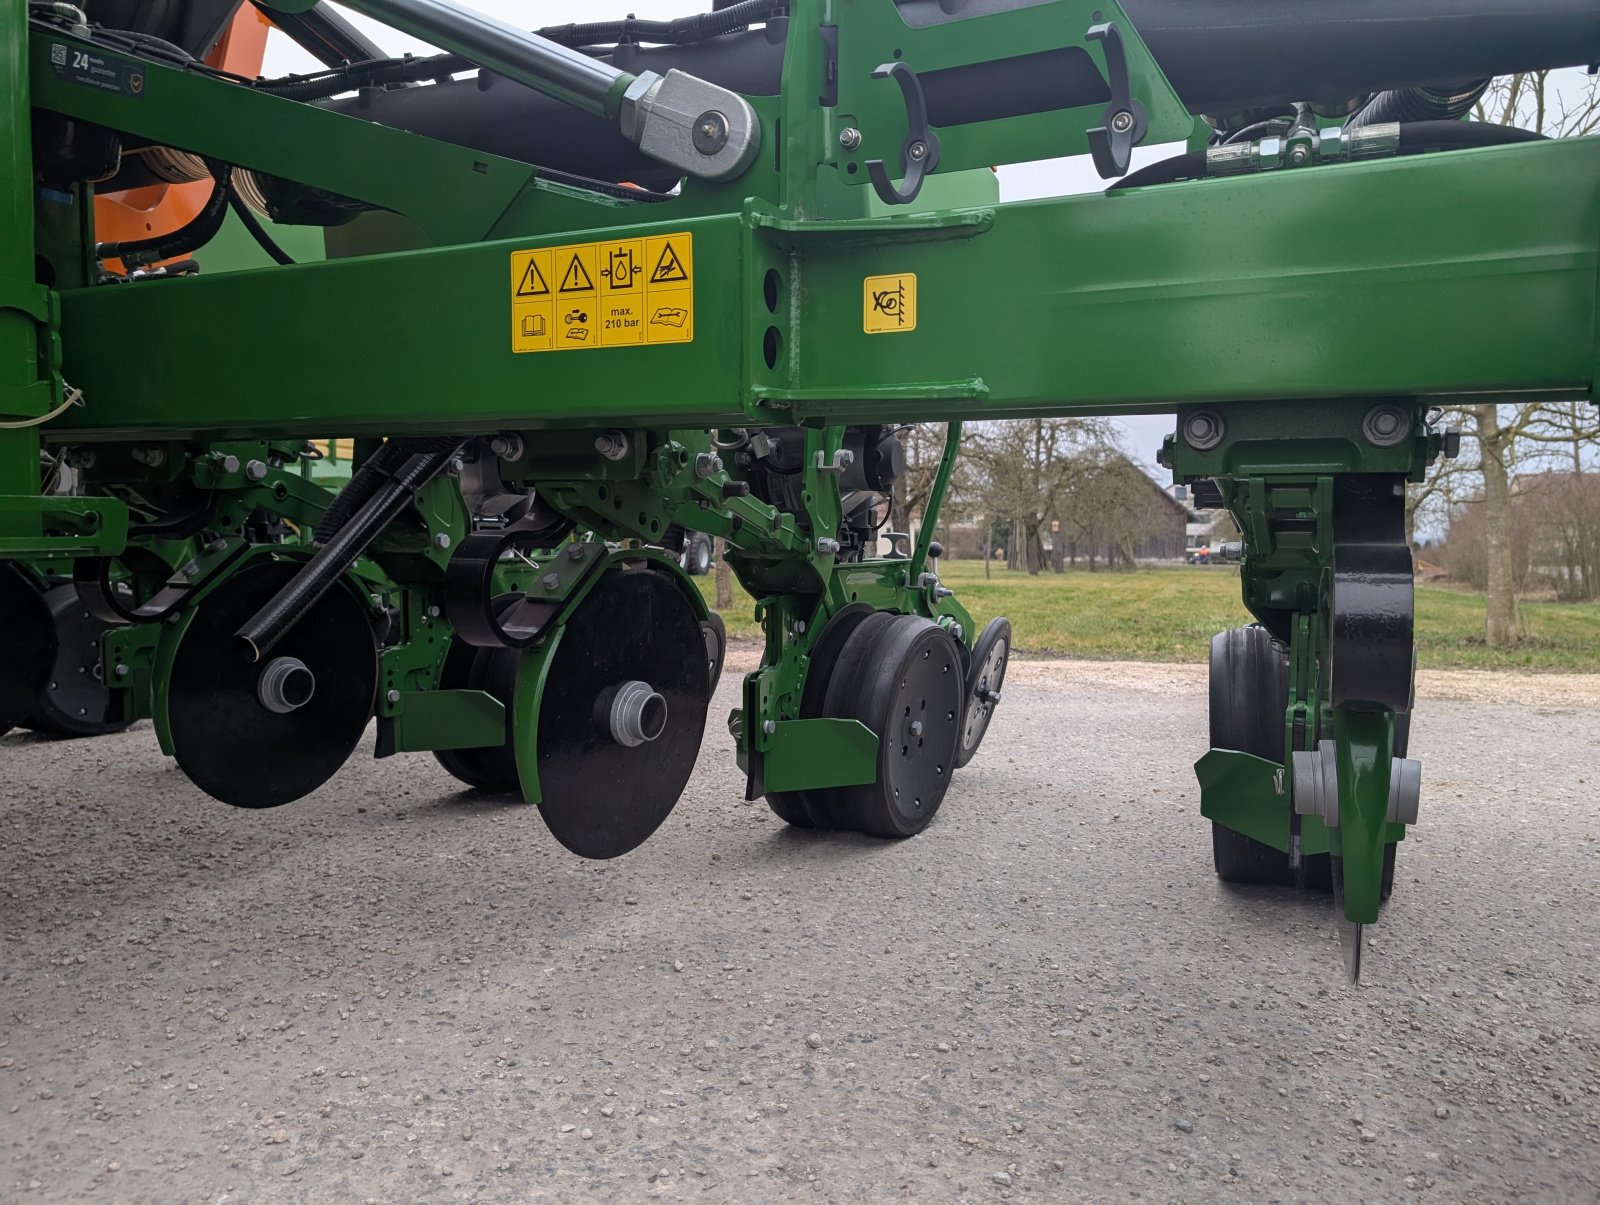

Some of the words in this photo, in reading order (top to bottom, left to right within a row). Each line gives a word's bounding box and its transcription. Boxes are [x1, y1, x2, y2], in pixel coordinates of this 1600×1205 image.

[73, 51, 89, 70] 24
[611, 308, 632, 316] max.
[605, 319, 621, 329] 210
[624, 318, 640, 327] bar
